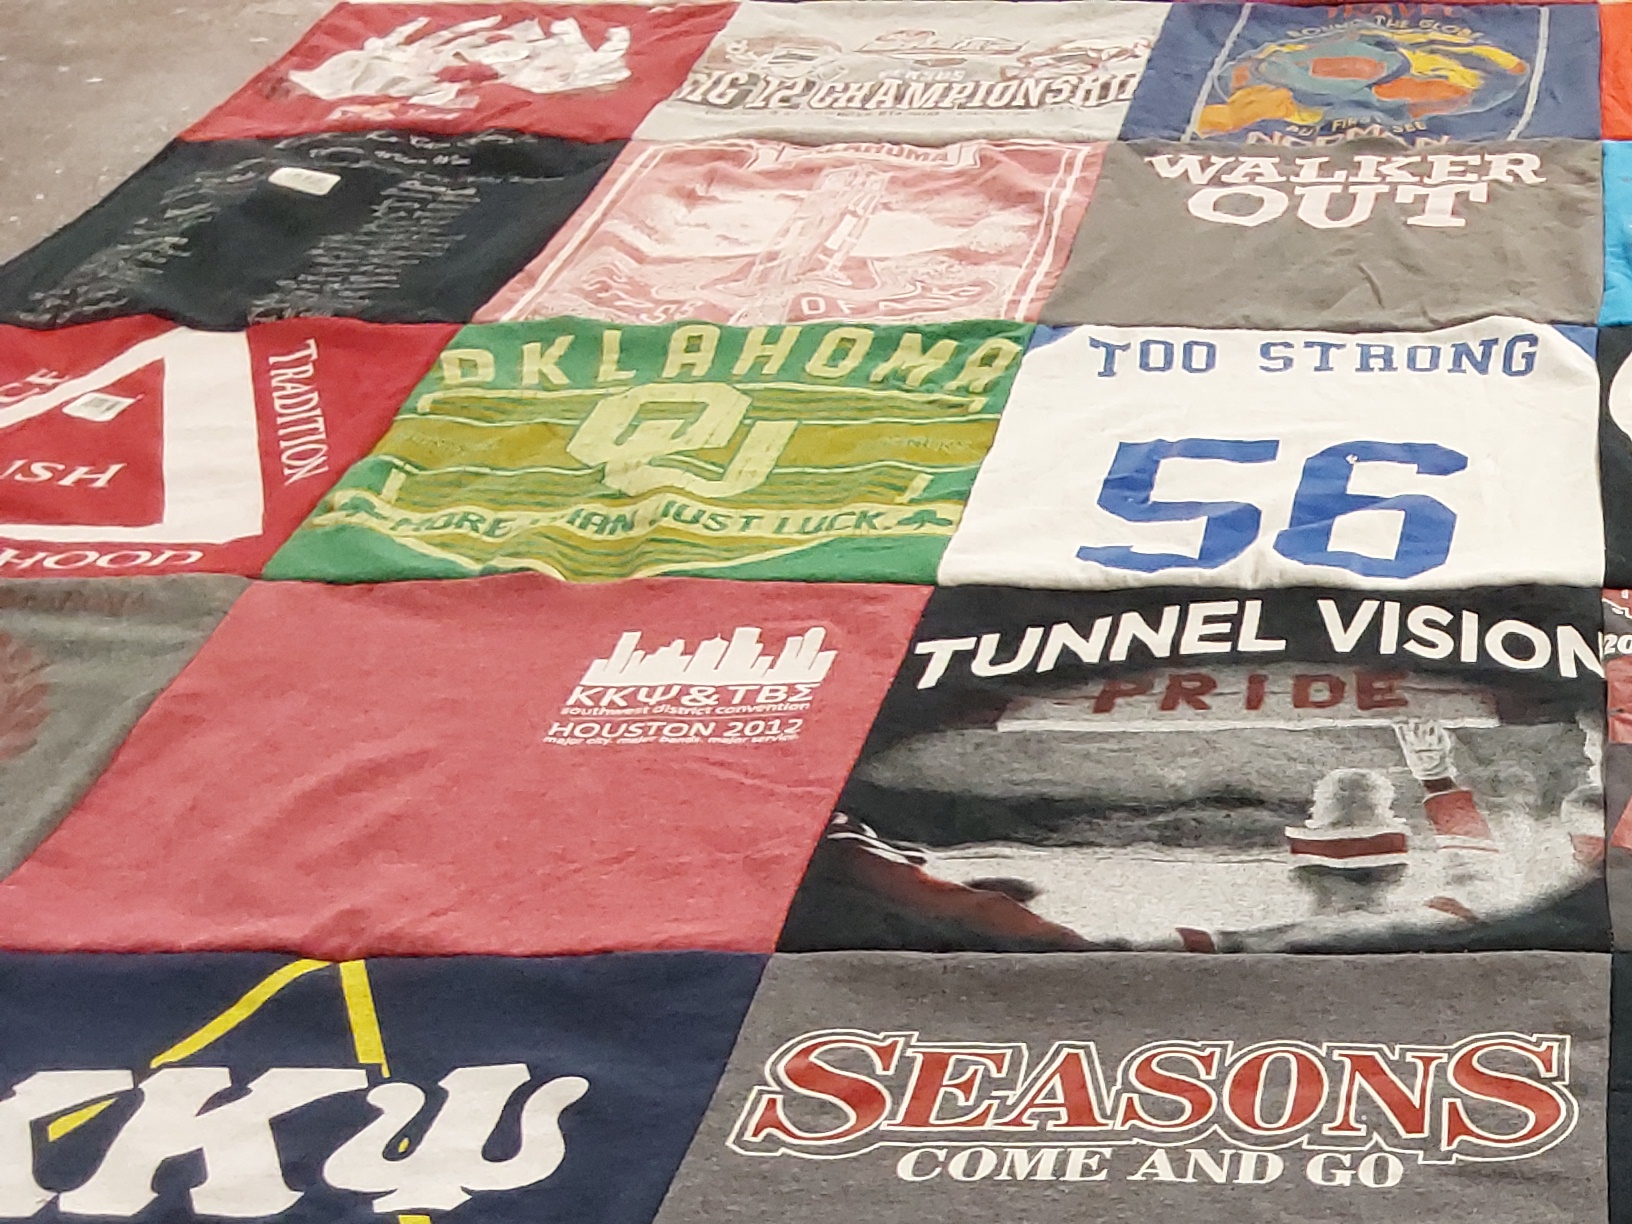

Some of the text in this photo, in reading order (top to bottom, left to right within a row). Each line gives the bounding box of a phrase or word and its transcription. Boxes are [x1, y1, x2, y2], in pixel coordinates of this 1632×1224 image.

[1145, 152, 1547, 185] WALKER
[1187, 181, 1489, 229] OUT
[440, 323, 1023, 394] OKLAHOMA
[1088, 332, 1540, 378] TOO STRONG
[267, 337, 331, 486] TRADITION
[1075, 437, 1469, 579] 56
[915, 599, 1287, 690] TUNNEL
[1316, 599, 1604, 679] VISION
[559, 702, 811, 716] southwest district convention
[1091, 667, 1410, 716] PRIDE
[547, 718, 804, 739] HOUSTON 2012
[727, 1029, 1579, 1161] SEASONS
[895, 1147, 1406, 1189] COME AND GO
